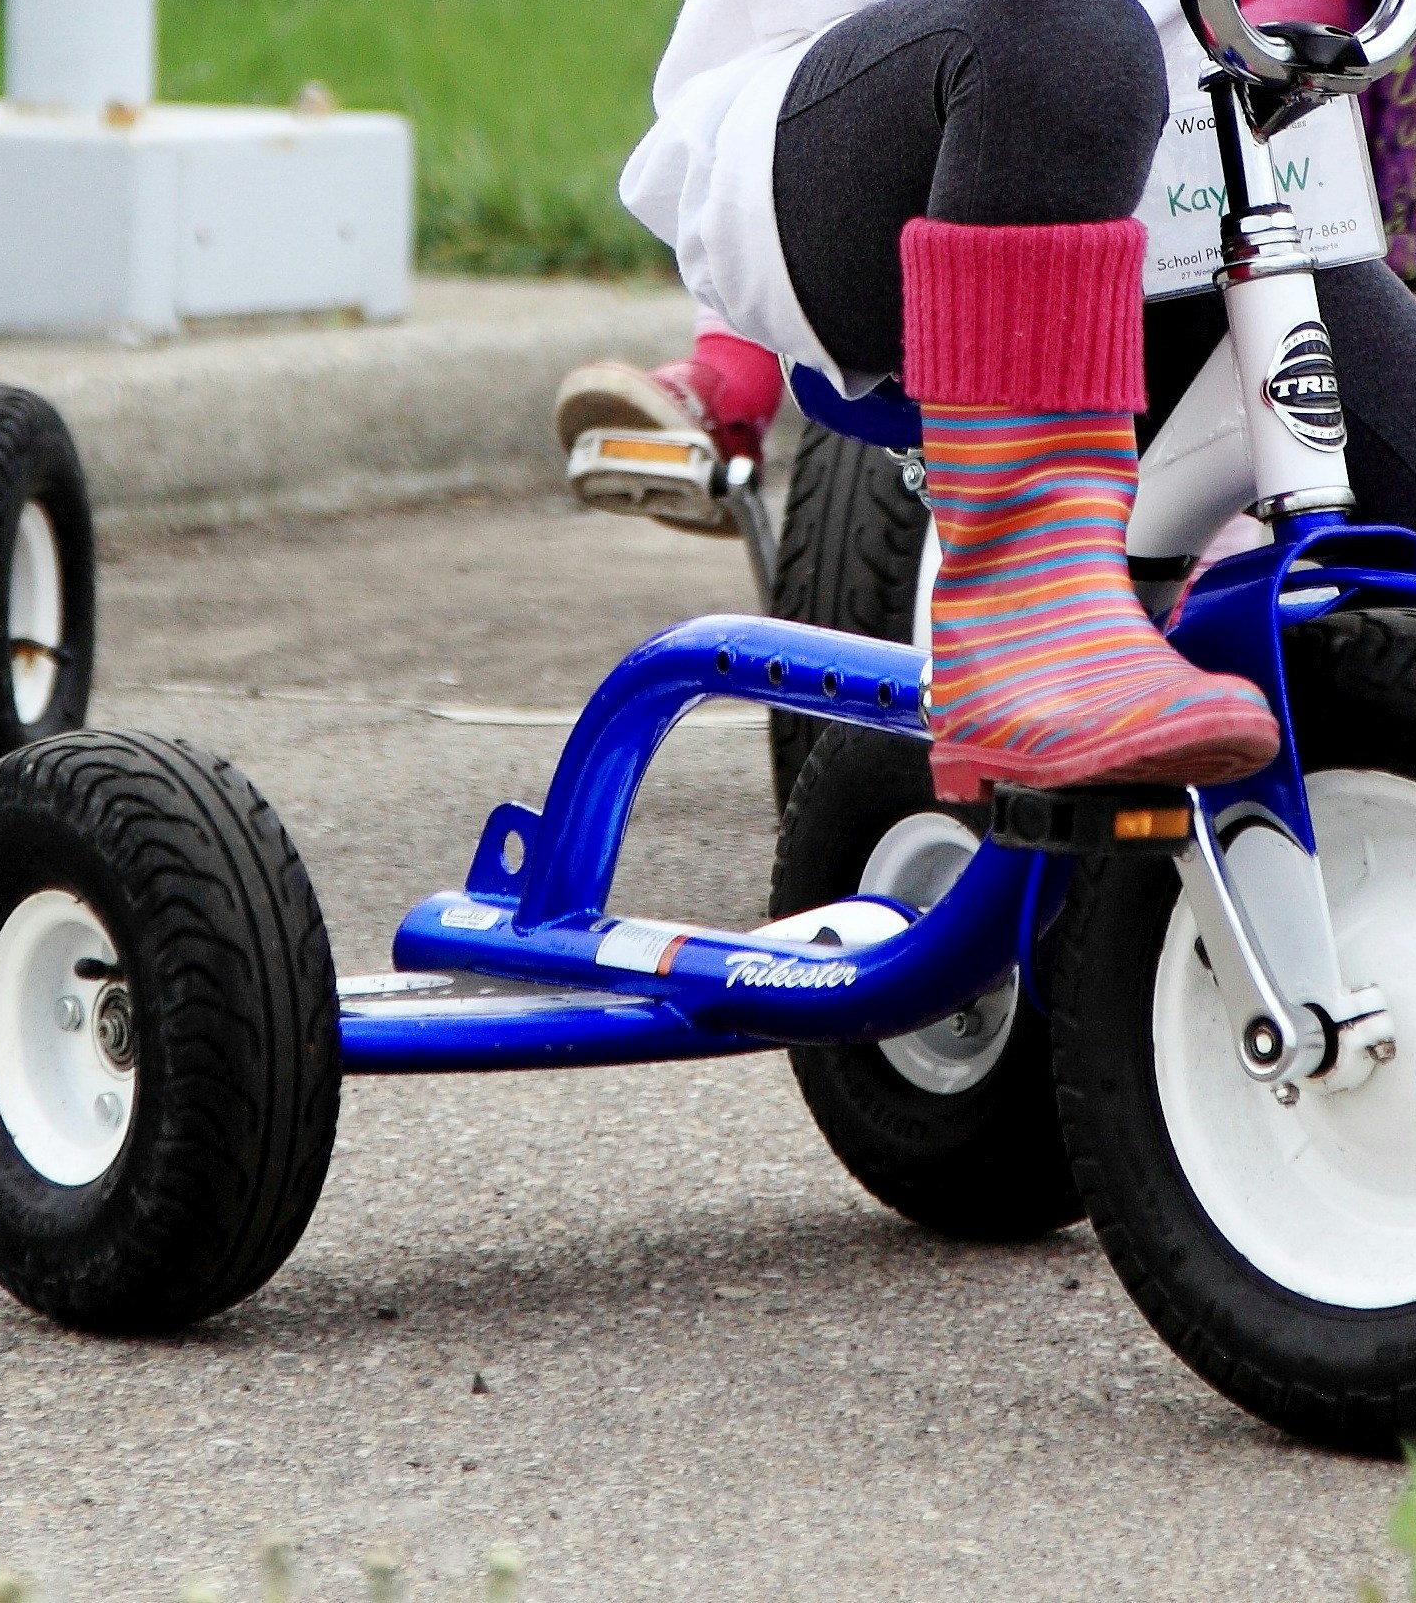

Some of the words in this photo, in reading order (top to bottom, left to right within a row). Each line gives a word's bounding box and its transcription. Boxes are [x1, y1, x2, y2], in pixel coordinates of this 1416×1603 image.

[1174, 116, 1217, 136] Woo
[1166, 182, 1227, 217] Kay
[1157, 249, 1202, 272] School
[1297, 218, 1357, 241] 77-8630
[1271, 374, 1340, 398] TRE
[724, 951, 859, 990] Trikester
